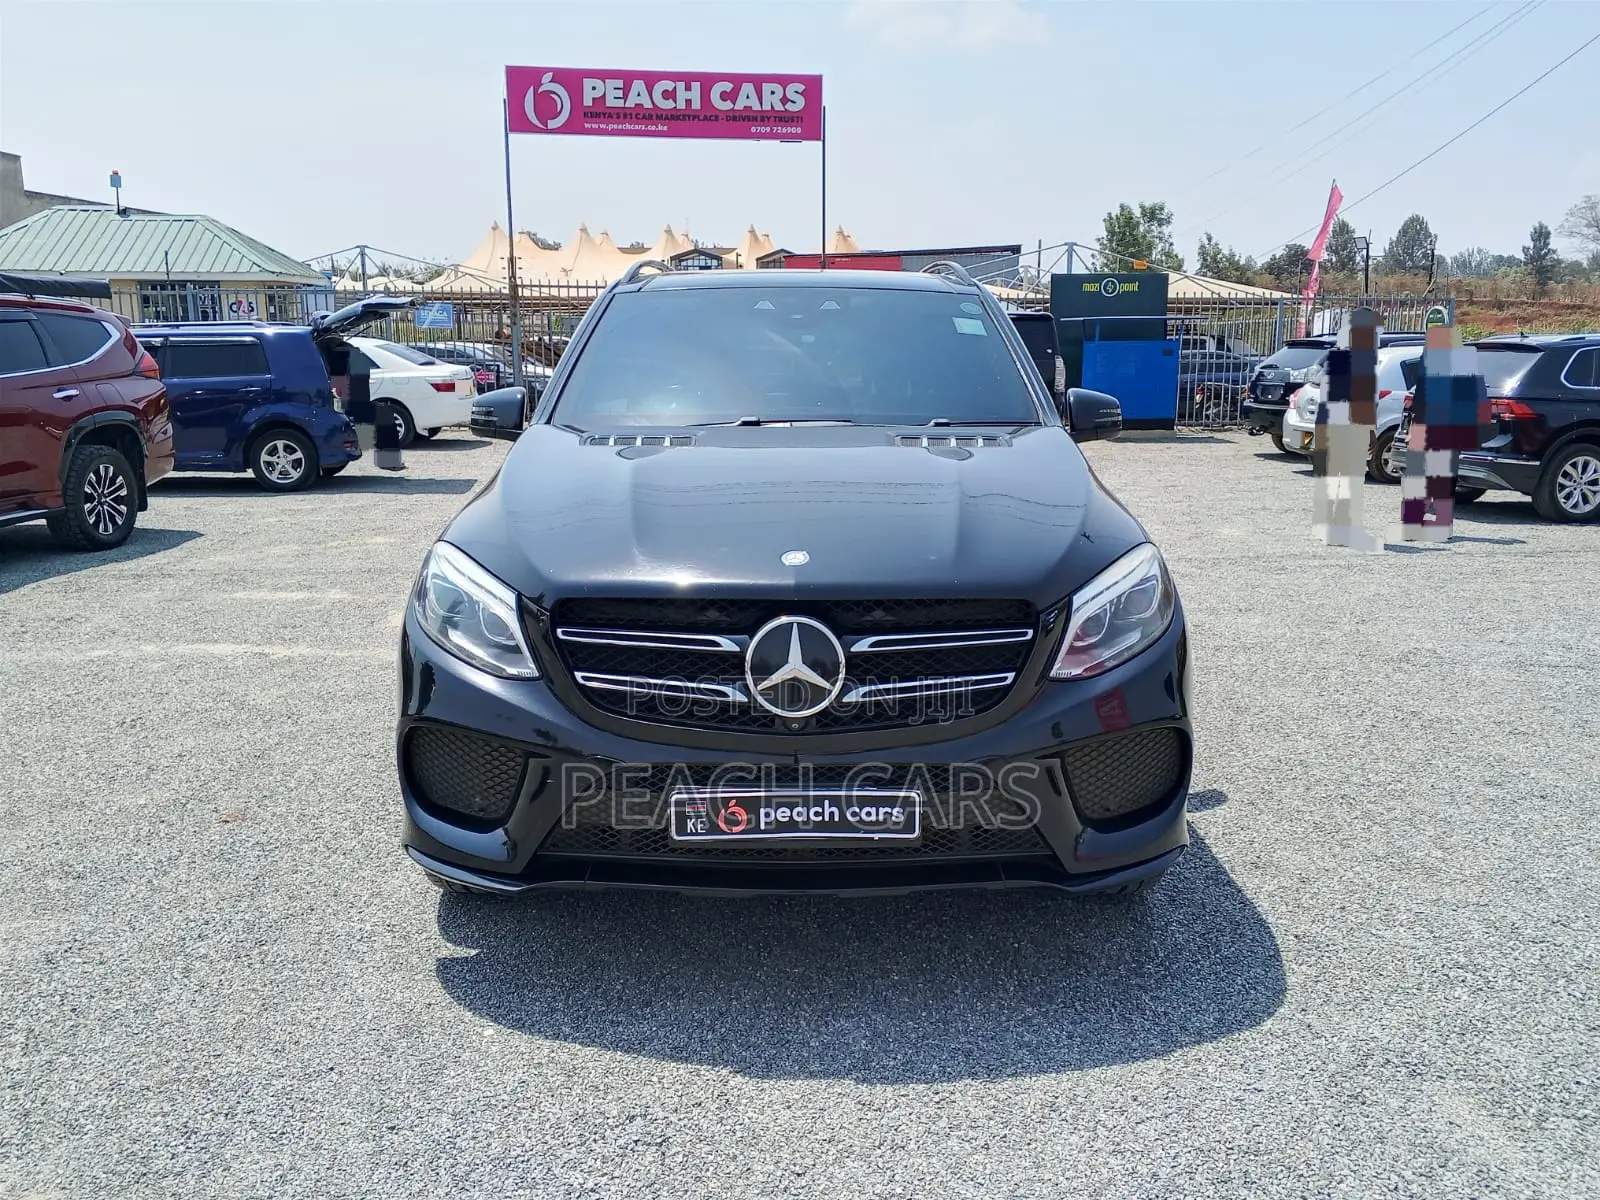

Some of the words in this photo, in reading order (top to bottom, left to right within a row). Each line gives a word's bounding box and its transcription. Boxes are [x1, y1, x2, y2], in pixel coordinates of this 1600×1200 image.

[582, 77, 701, 110] PEACH
[709, 81, 806, 112] CARS
[583, 111, 620, 120] KENYA'S
[634, 113, 655, 121] CAR
[655, 113, 720, 122] MARKETPLACE
[772, 115, 804, 123] TRUST!
[584, 122, 668, 131] www.peachcars.co.ke
[1119, 281, 1139, 294] point
[759, 800, 840, 830] peach
[846, 806, 905, 823] cars
[687, 818, 707, 833] KE
